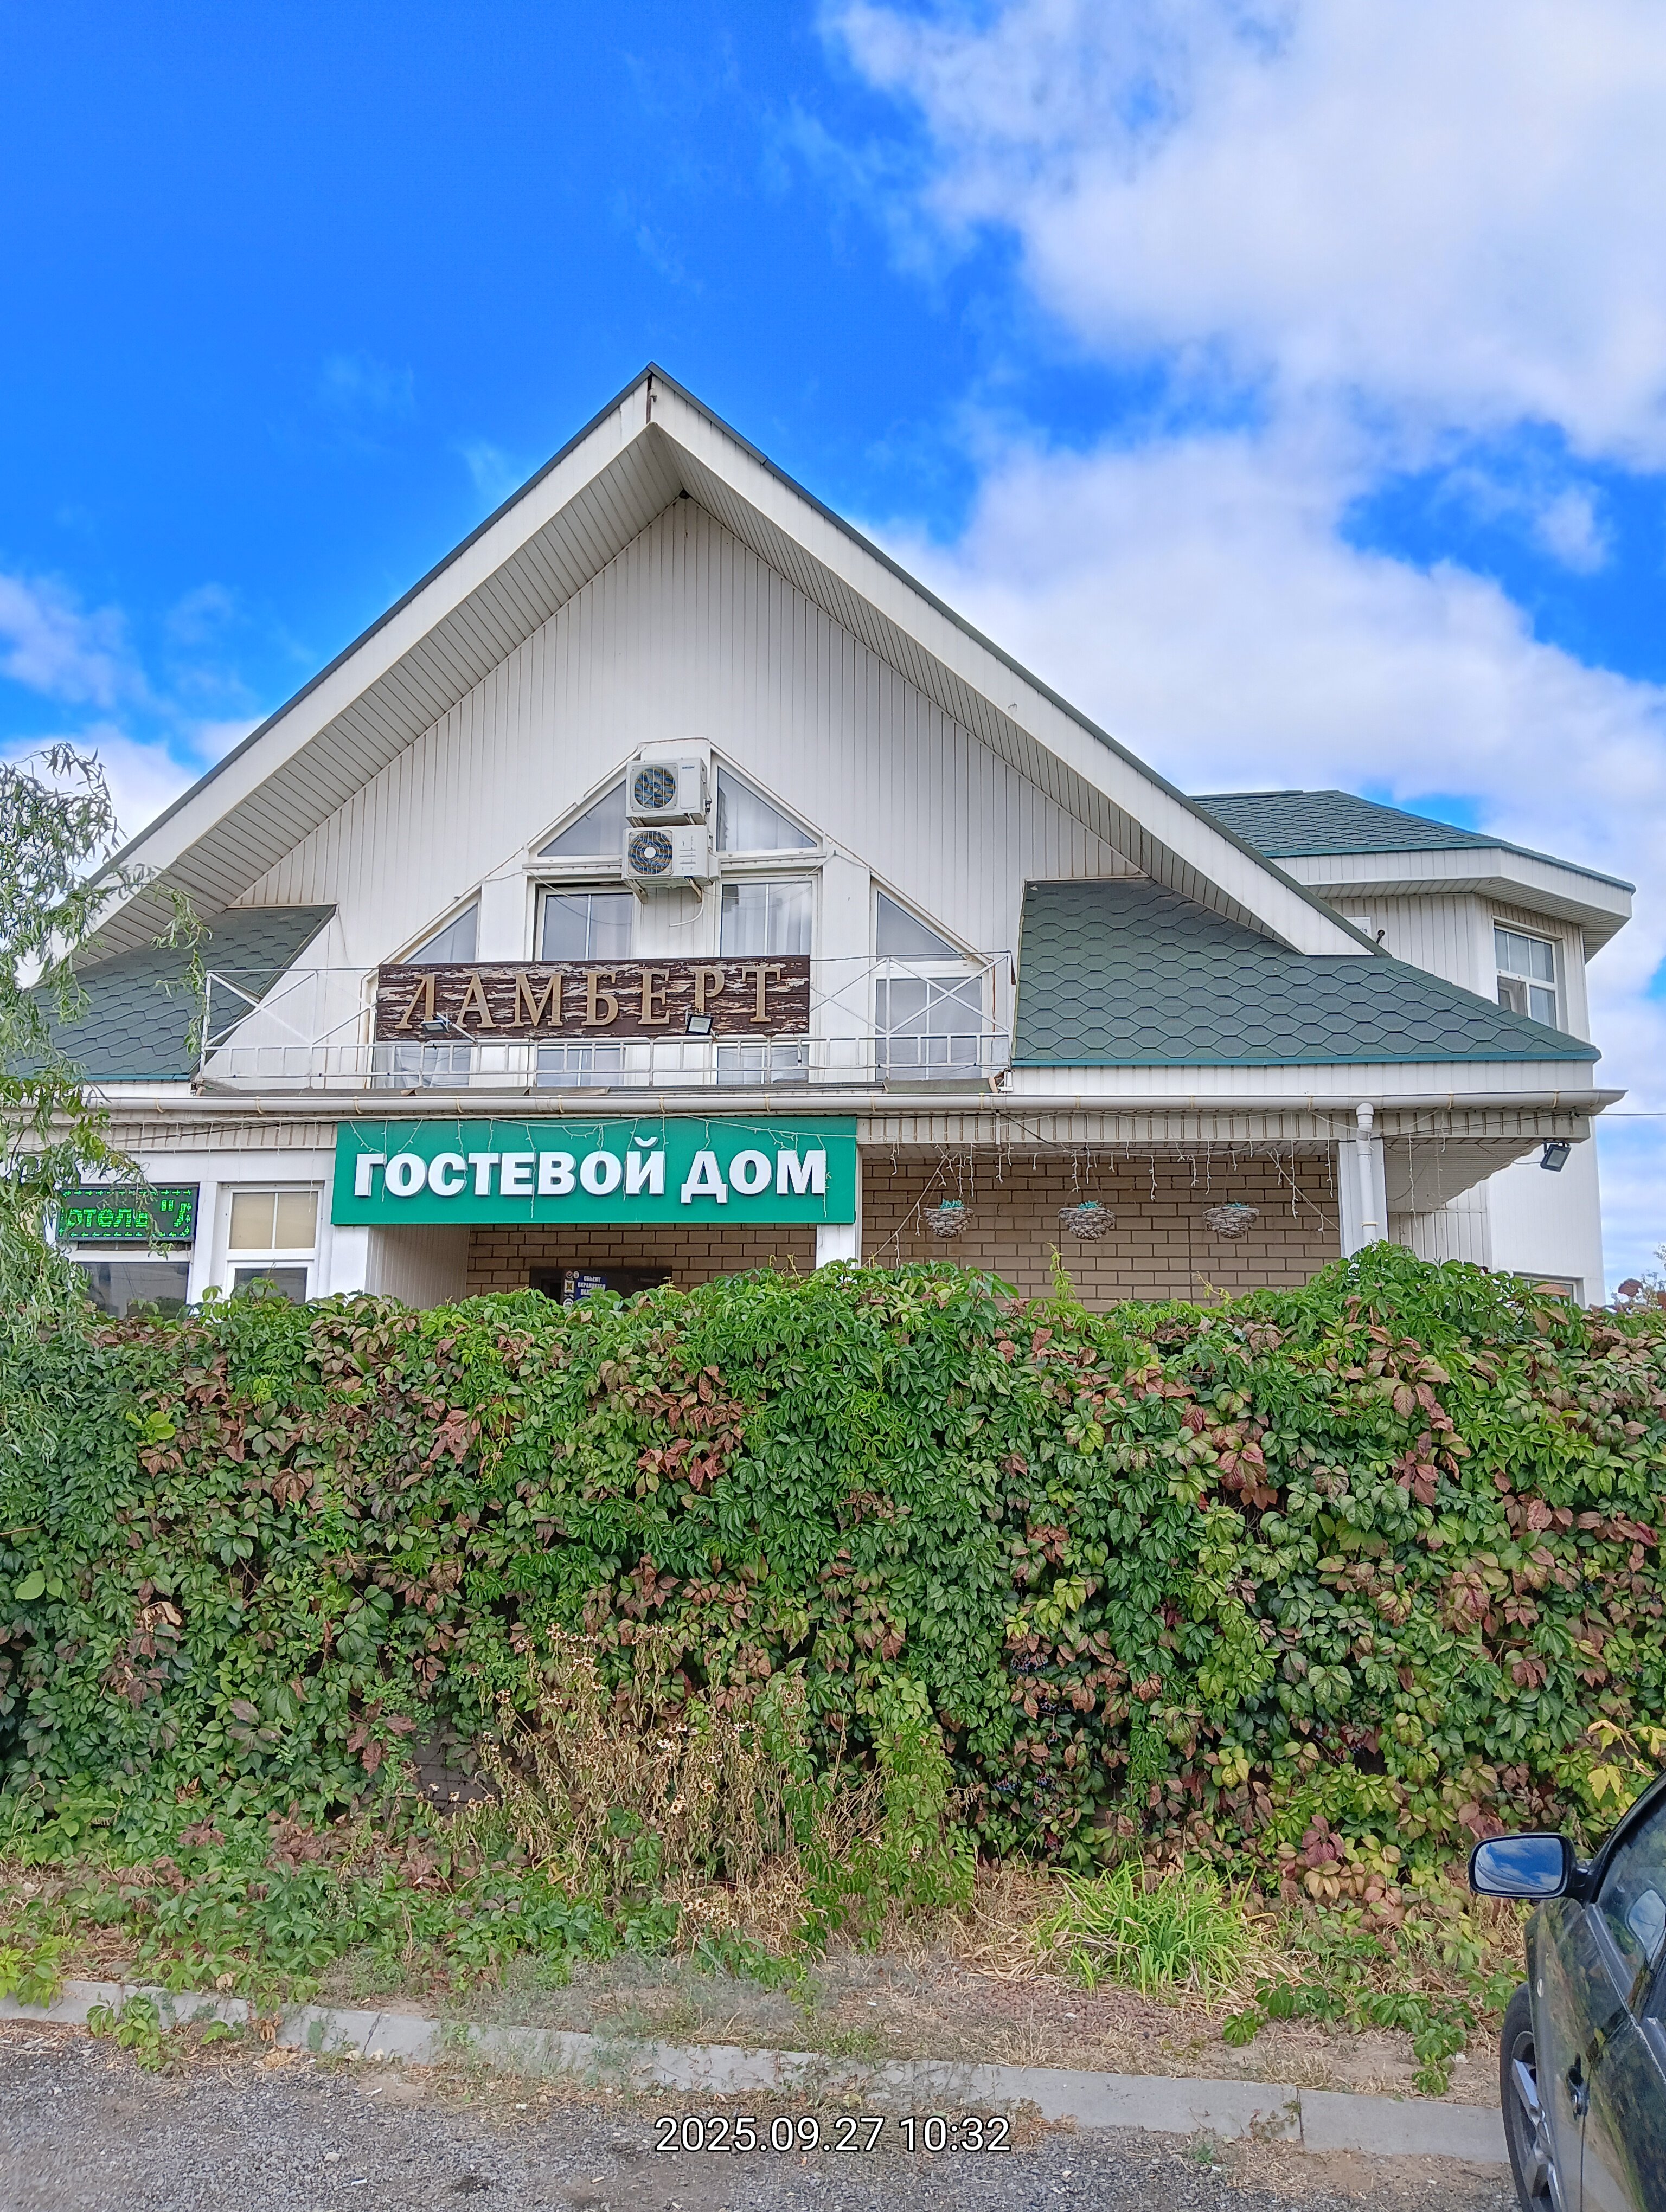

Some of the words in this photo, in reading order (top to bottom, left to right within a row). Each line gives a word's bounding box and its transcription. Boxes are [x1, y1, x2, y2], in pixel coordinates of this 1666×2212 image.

[395, 967, 781, 1030] ЛАМБЕРТ
[354, 1137, 665, 1197] ГОСТЕВОЙ
[681, 1149, 826, 1203] ДОМ
